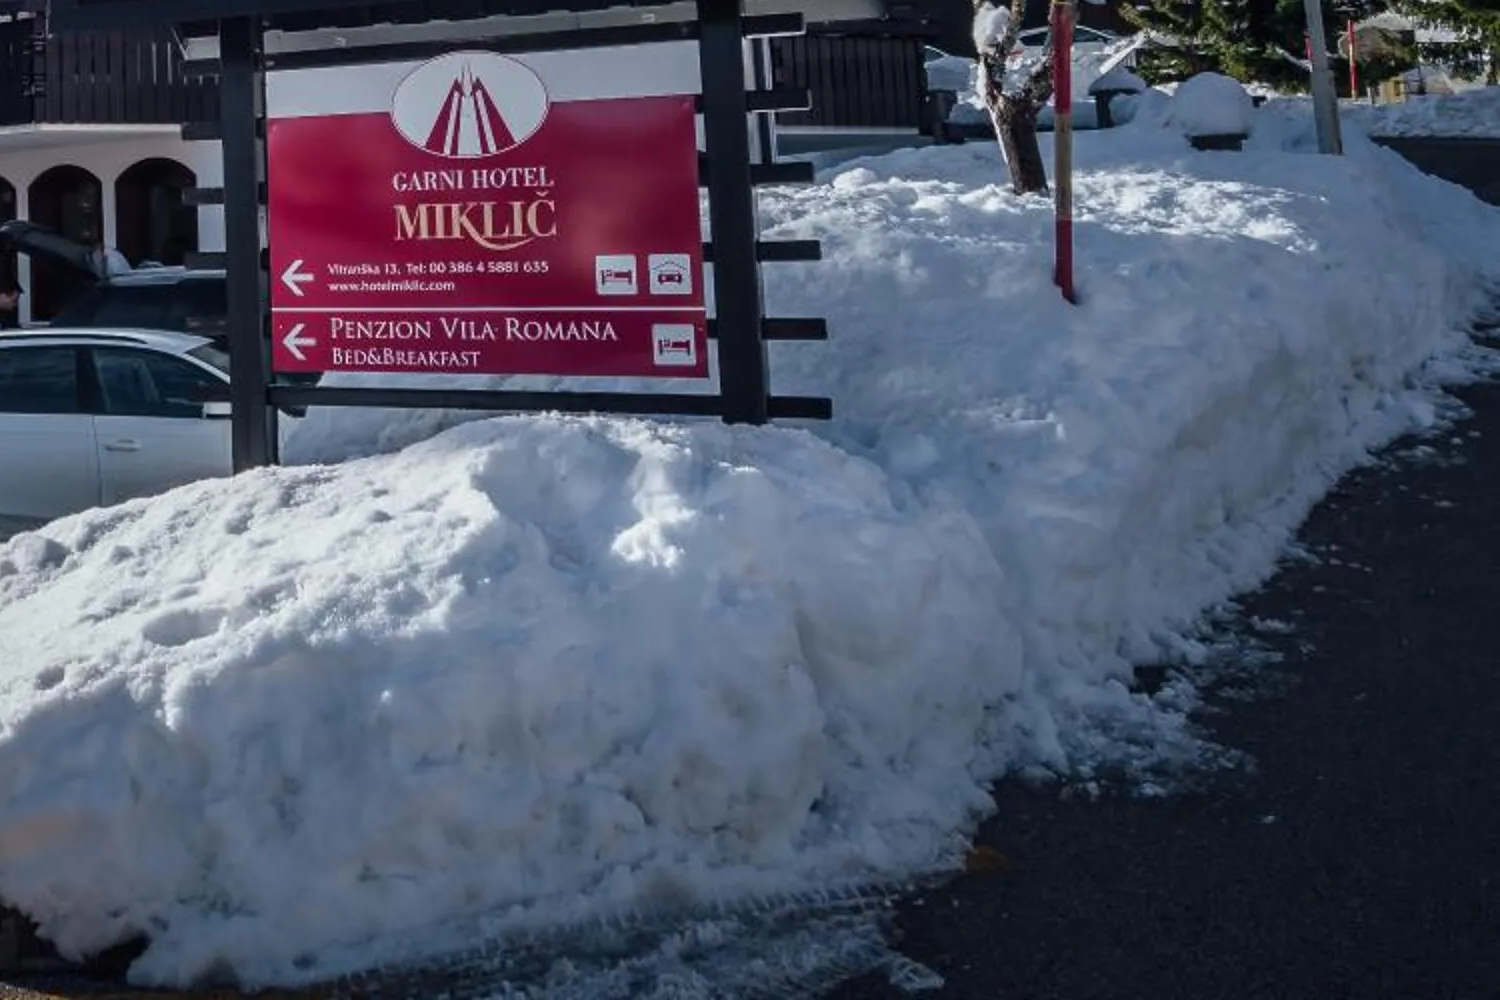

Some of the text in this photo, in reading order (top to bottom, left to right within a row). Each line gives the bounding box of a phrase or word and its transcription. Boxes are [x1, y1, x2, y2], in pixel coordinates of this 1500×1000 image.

[393, 166, 555, 192] GARNI HOTEL
[393, 189, 557, 251] MIKLIČ
[406, 262, 427, 275] Tel:
[428, 261, 447, 274] 00
[449, 261, 473, 273] 386
[475, 261, 486, 273] 4
[487, 260, 519, 273] 5881
[523, 260, 549, 273] 635
[327, 279, 456, 292] www.hotelmiklic.com
[329, 317, 619, 341] PENZION VILA ROMANA
[332, 347, 482, 368] BED&BREAKFAST
